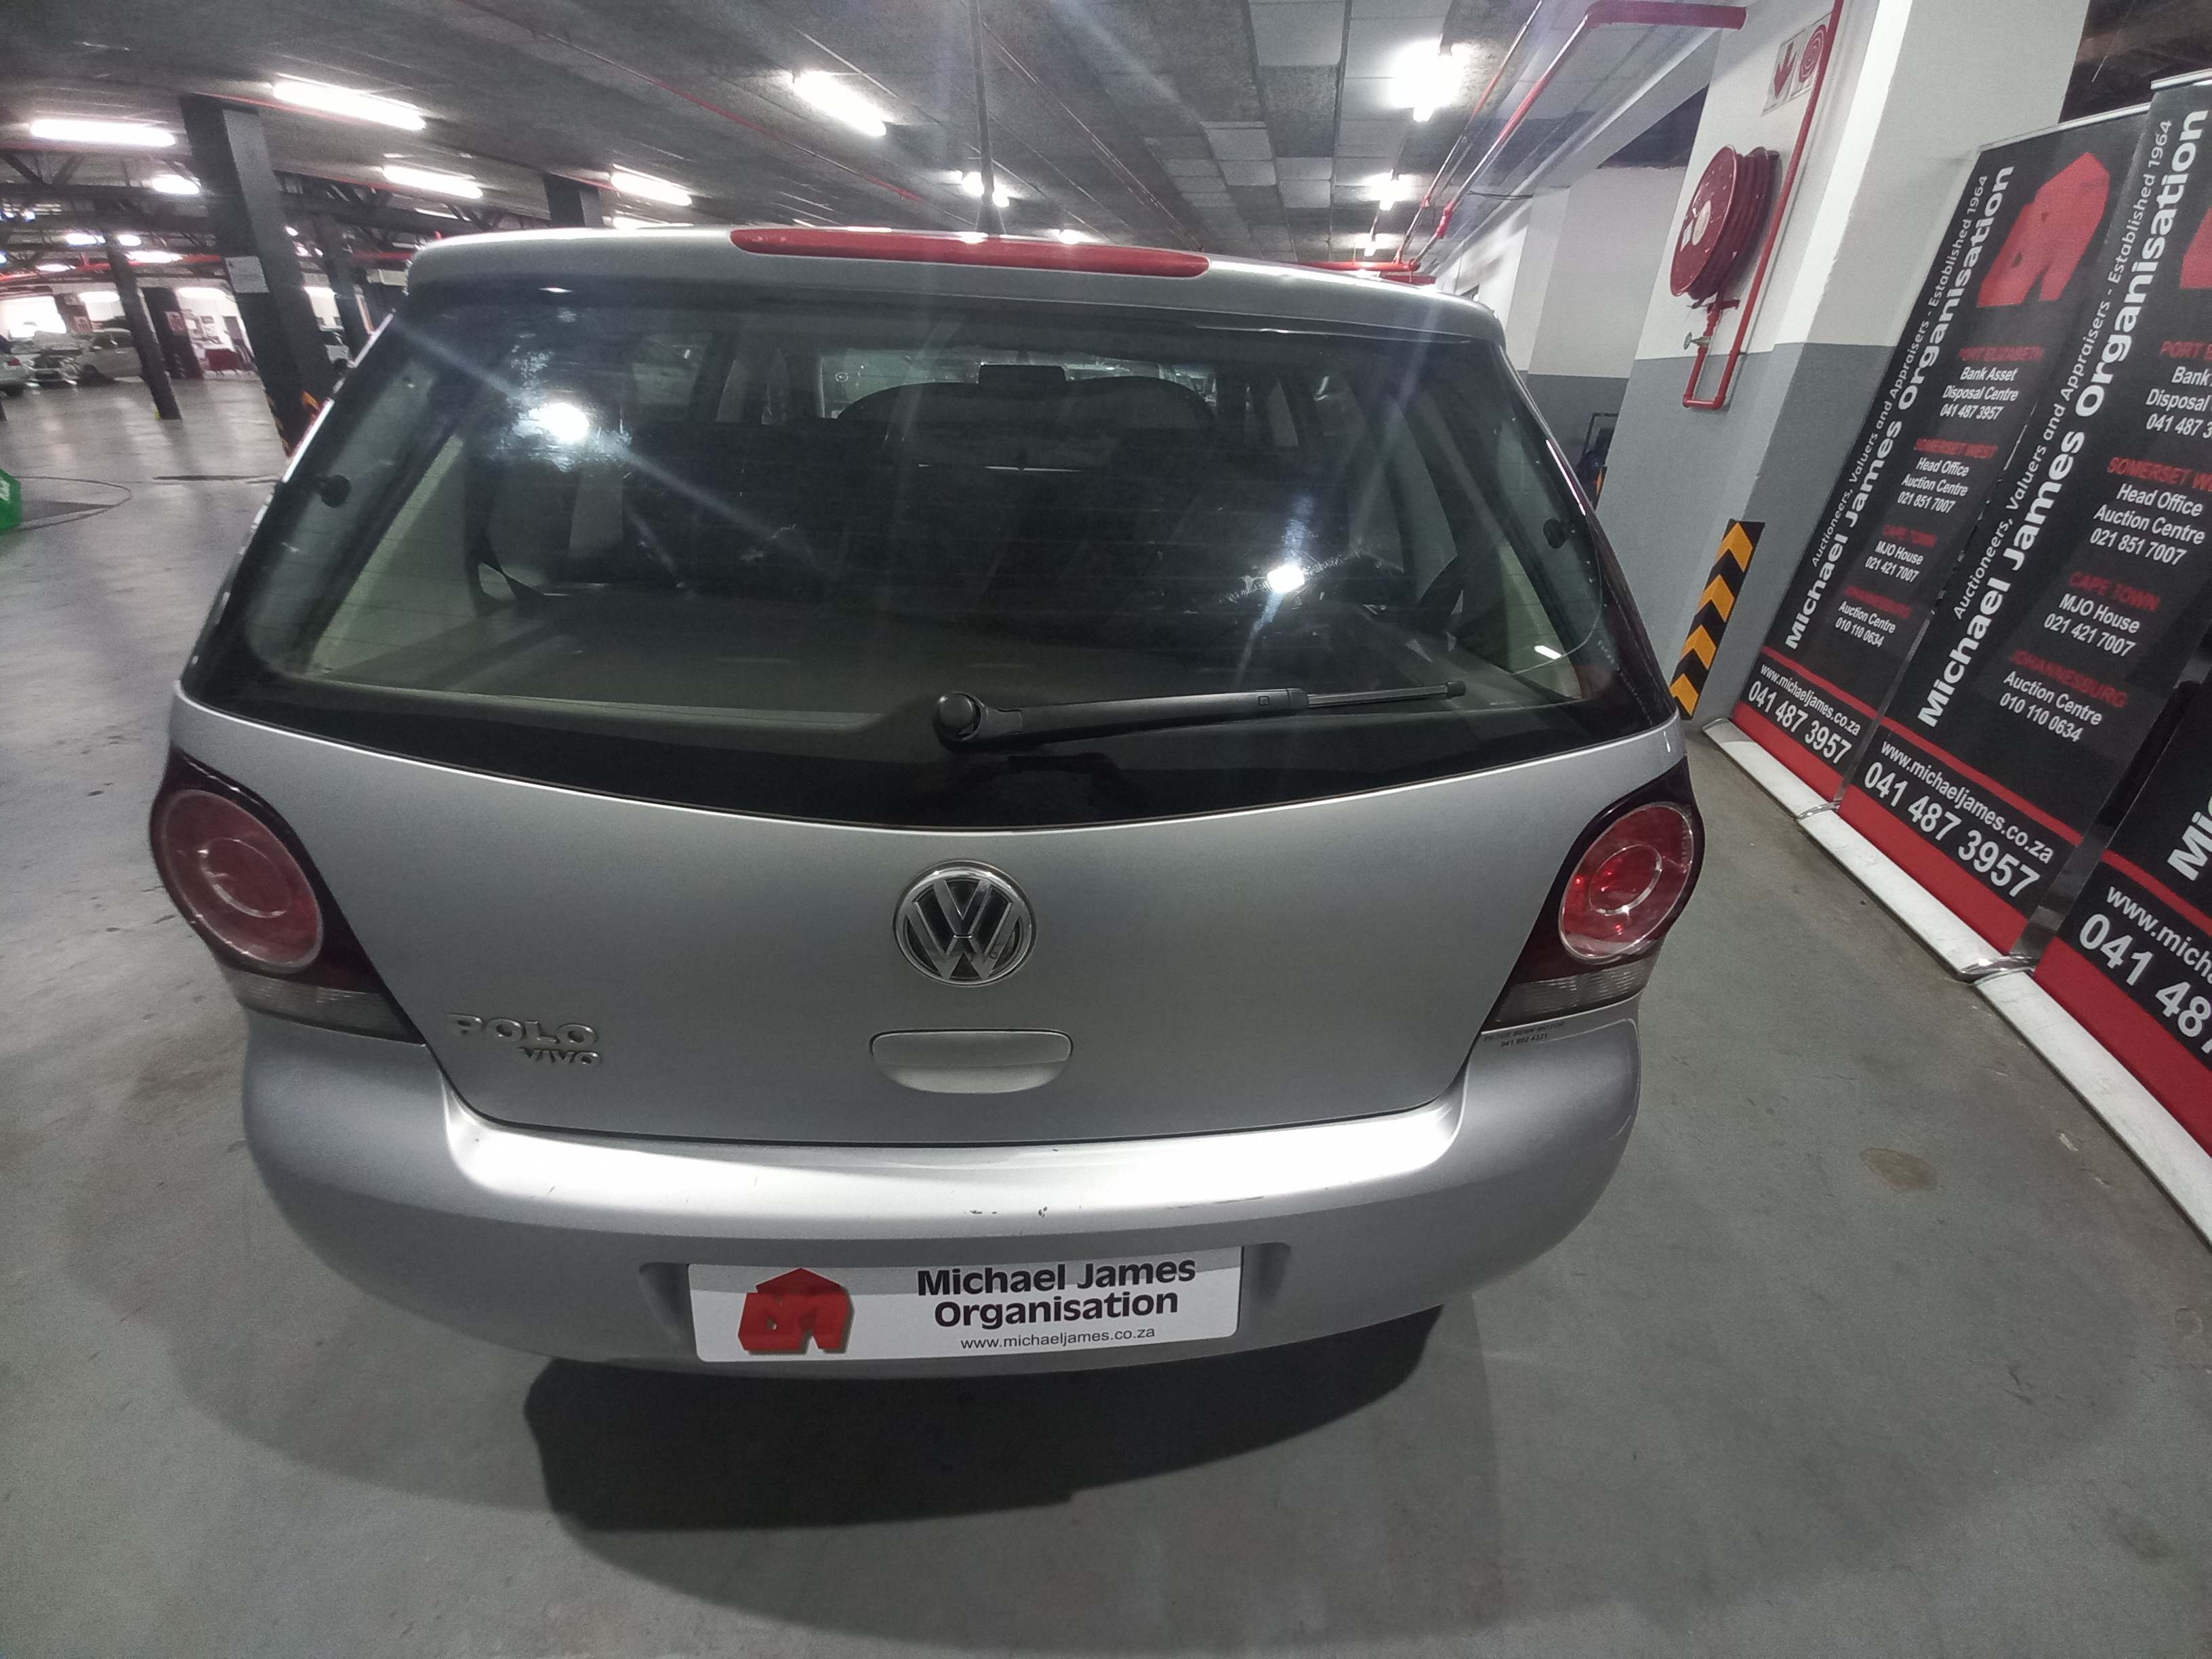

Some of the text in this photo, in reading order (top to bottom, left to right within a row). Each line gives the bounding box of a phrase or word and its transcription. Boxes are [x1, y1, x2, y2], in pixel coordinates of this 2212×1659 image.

[1813, 487, 1853, 568] Auctioneers,
[1849, 431, 1878, 483] Valuers
[1876, 401, 1892, 430] and
[1890, 321, 1929, 398] Appraisers
[1928, 219, 1971, 307] Established
[1966, 175, 1988, 214] 1964
[1953, 517, 2013, 620] Auctioneers,
[2005, 444, 2047, 510] Valuers
[2042, 403, 2066, 441] and
[2060, 300, 2111, 402] Appraisers
[2108, 173, 2157, 283] Established
[2148, 119, 2173, 169] 1964
[1959, 366, 2019, 382] Bank Asset
[2171, 366, 2210, 386] Bank
[1784, 533, 1849, 649] Michael
[1844, 420, 1902, 527] James
[1898, 166, 2014, 410] Organisation
[1940, 405, 2005, 420] 041 487 3957
[1942, 385, 2020, 403] Disposal Centre
[2145, 388, 2211, 412] Disposal
[1917, 110, 2209, 727] Michael James Organisation
[2146, 413, 2174, 432] 041
[2174, 417, 2205, 436] 487
[1901, 474, 1969, 497] Auction Centre
[1916, 457, 1970, 478] Head Office
[1897, 491, 1957, 514] 021 851 7007
[2115, 483, 2204, 518] Head Office
[2093, 504, 2207, 546] Auction Centre
[1875, 540, 1924, 565] MJO House
[2089, 527, 2188, 567] 021 851 7007
[1864, 556, 1921, 583] 021 421 7007
[1835, 617, 1886, 648] 010 110 0634
[1838, 600, 1869, 622] Auction
[1867, 612, 1897, 634] Centre
[2058, 593, 2141, 634] MJO House
[2044, 613, 2137, 657] 021 421 7007
[1760, 663, 1862, 737] www.michaeljames.co.za
[1999, 692, 2084, 742] 010 110 0634
[2003, 671, 2103, 726] Auction Centre
[1748, 680, 1853, 764] 041 487 3957
[1881, 741, 2055, 864] www.michaeljames.co.za
[1864, 761, 2041, 898] 041 487 3957
[900, 869, 1027, 983] VW
[2078, 913, 2154, 986] 041
[445, 1011, 599, 1050] POLO
[518, 1046, 602, 1067] VIVO
[917, 1258, 1197, 1296] Michael James
[934, 1290, 1179, 1330] Organisation
[960, 1327, 1155, 1350] www.michaeljames.co.za
